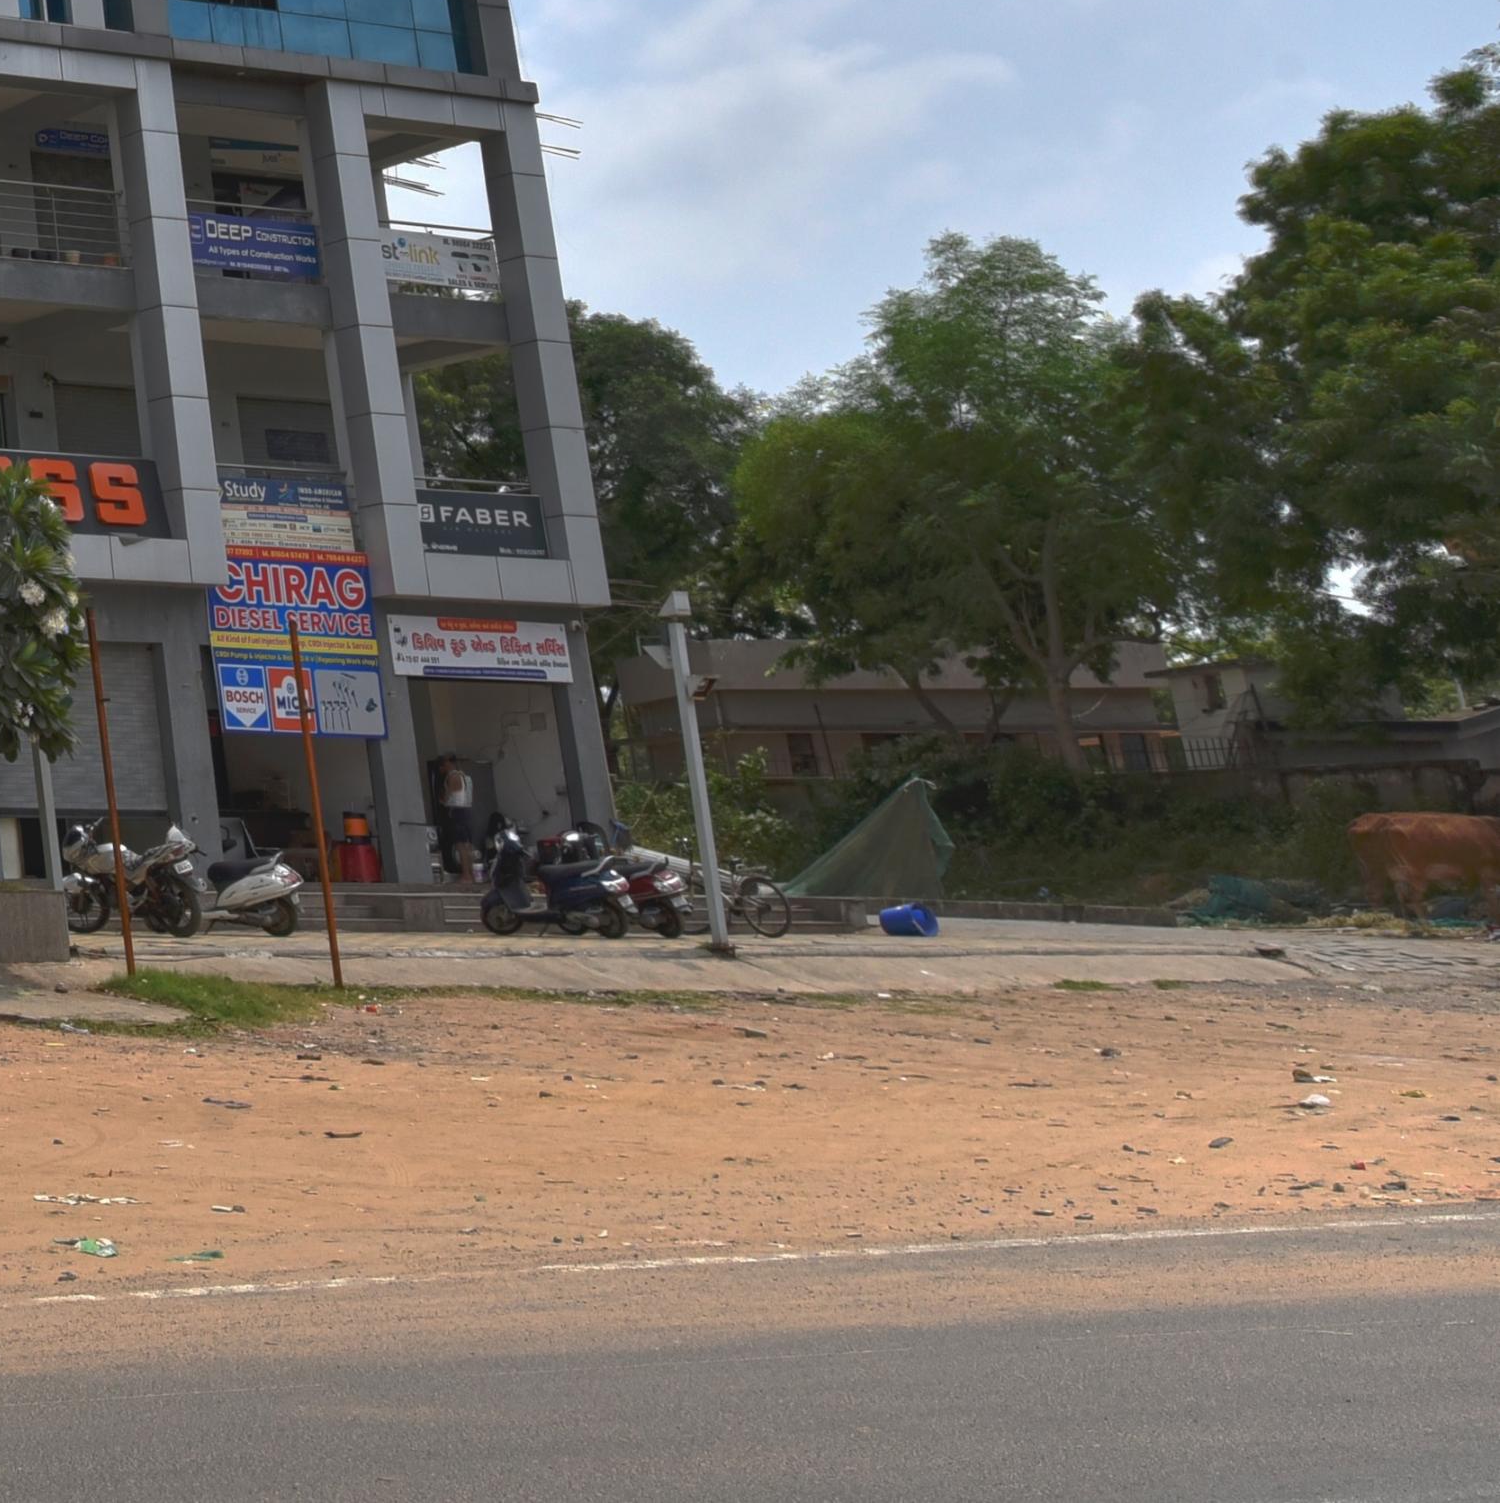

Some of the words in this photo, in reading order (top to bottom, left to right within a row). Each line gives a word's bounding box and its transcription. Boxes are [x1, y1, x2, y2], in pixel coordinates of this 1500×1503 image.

[205, 219, 253, 242] DEEP
[255, 230, 315, 247] CONSTRUCTION
[219, 246, 240, 257] Types
[241, 248, 249, 257] of
[250, 249, 294, 262] Construction
[223, 480, 266, 502] Study
[439, 505, 532, 528] FABER
[215, 561, 367, 610] CHIRAG
[214, 605, 283, 632] DIESEL
[286, 609, 373, 637] SERVICE
[225, 689, 264, 705] BOSCH
[276, 694, 306, 711] MIC
[236, 706, 257, 715] SERVICE
